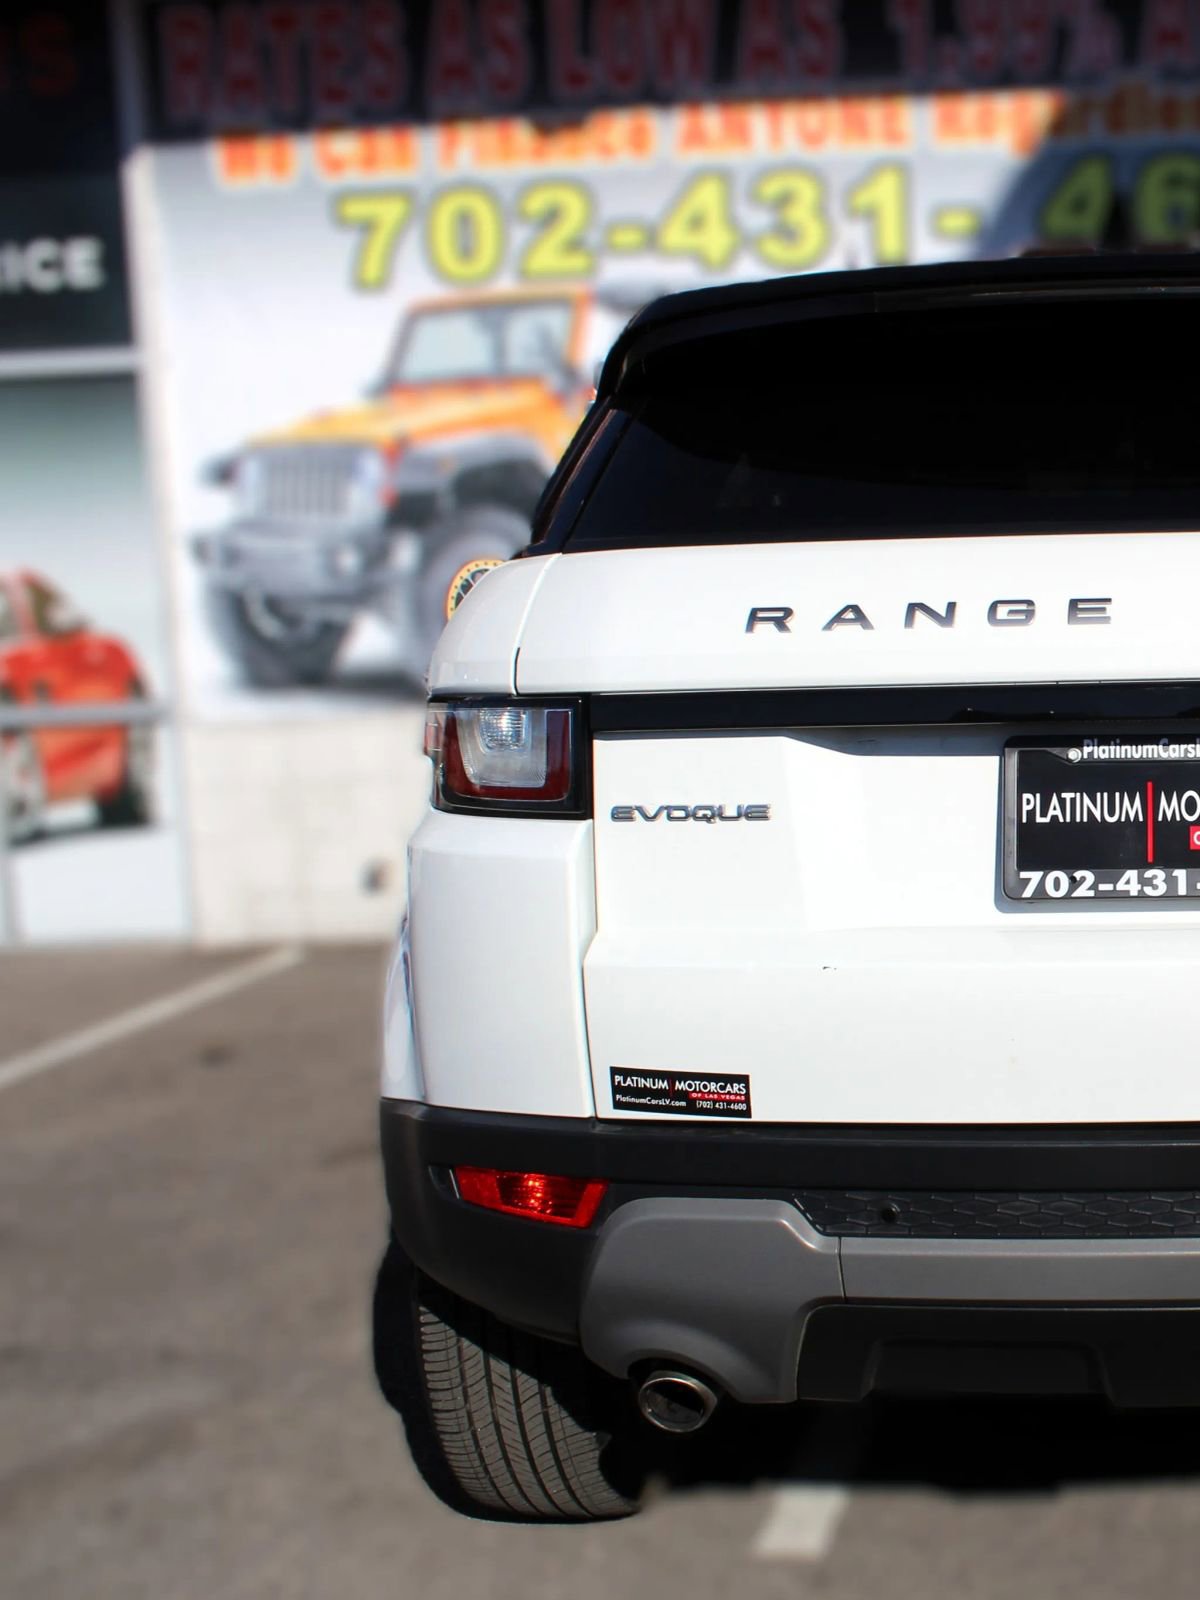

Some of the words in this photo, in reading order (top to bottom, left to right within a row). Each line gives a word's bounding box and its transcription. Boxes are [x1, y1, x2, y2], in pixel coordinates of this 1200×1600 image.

[428, 0, 528, 106] AS
[548, 0, 712, 98] LOW
[745, 598, 1112, 634] RANGE
[611, 804, 770, 824] EVOQUE
[1021, 791, 1143, 824] PLATINUM
[614, 1075, 669, 1090] PLATINUM
[674, 1081, 746, 1094] MOTORCARS
[615, 1094, 687, 1107] PlatinumCarsLV.com
